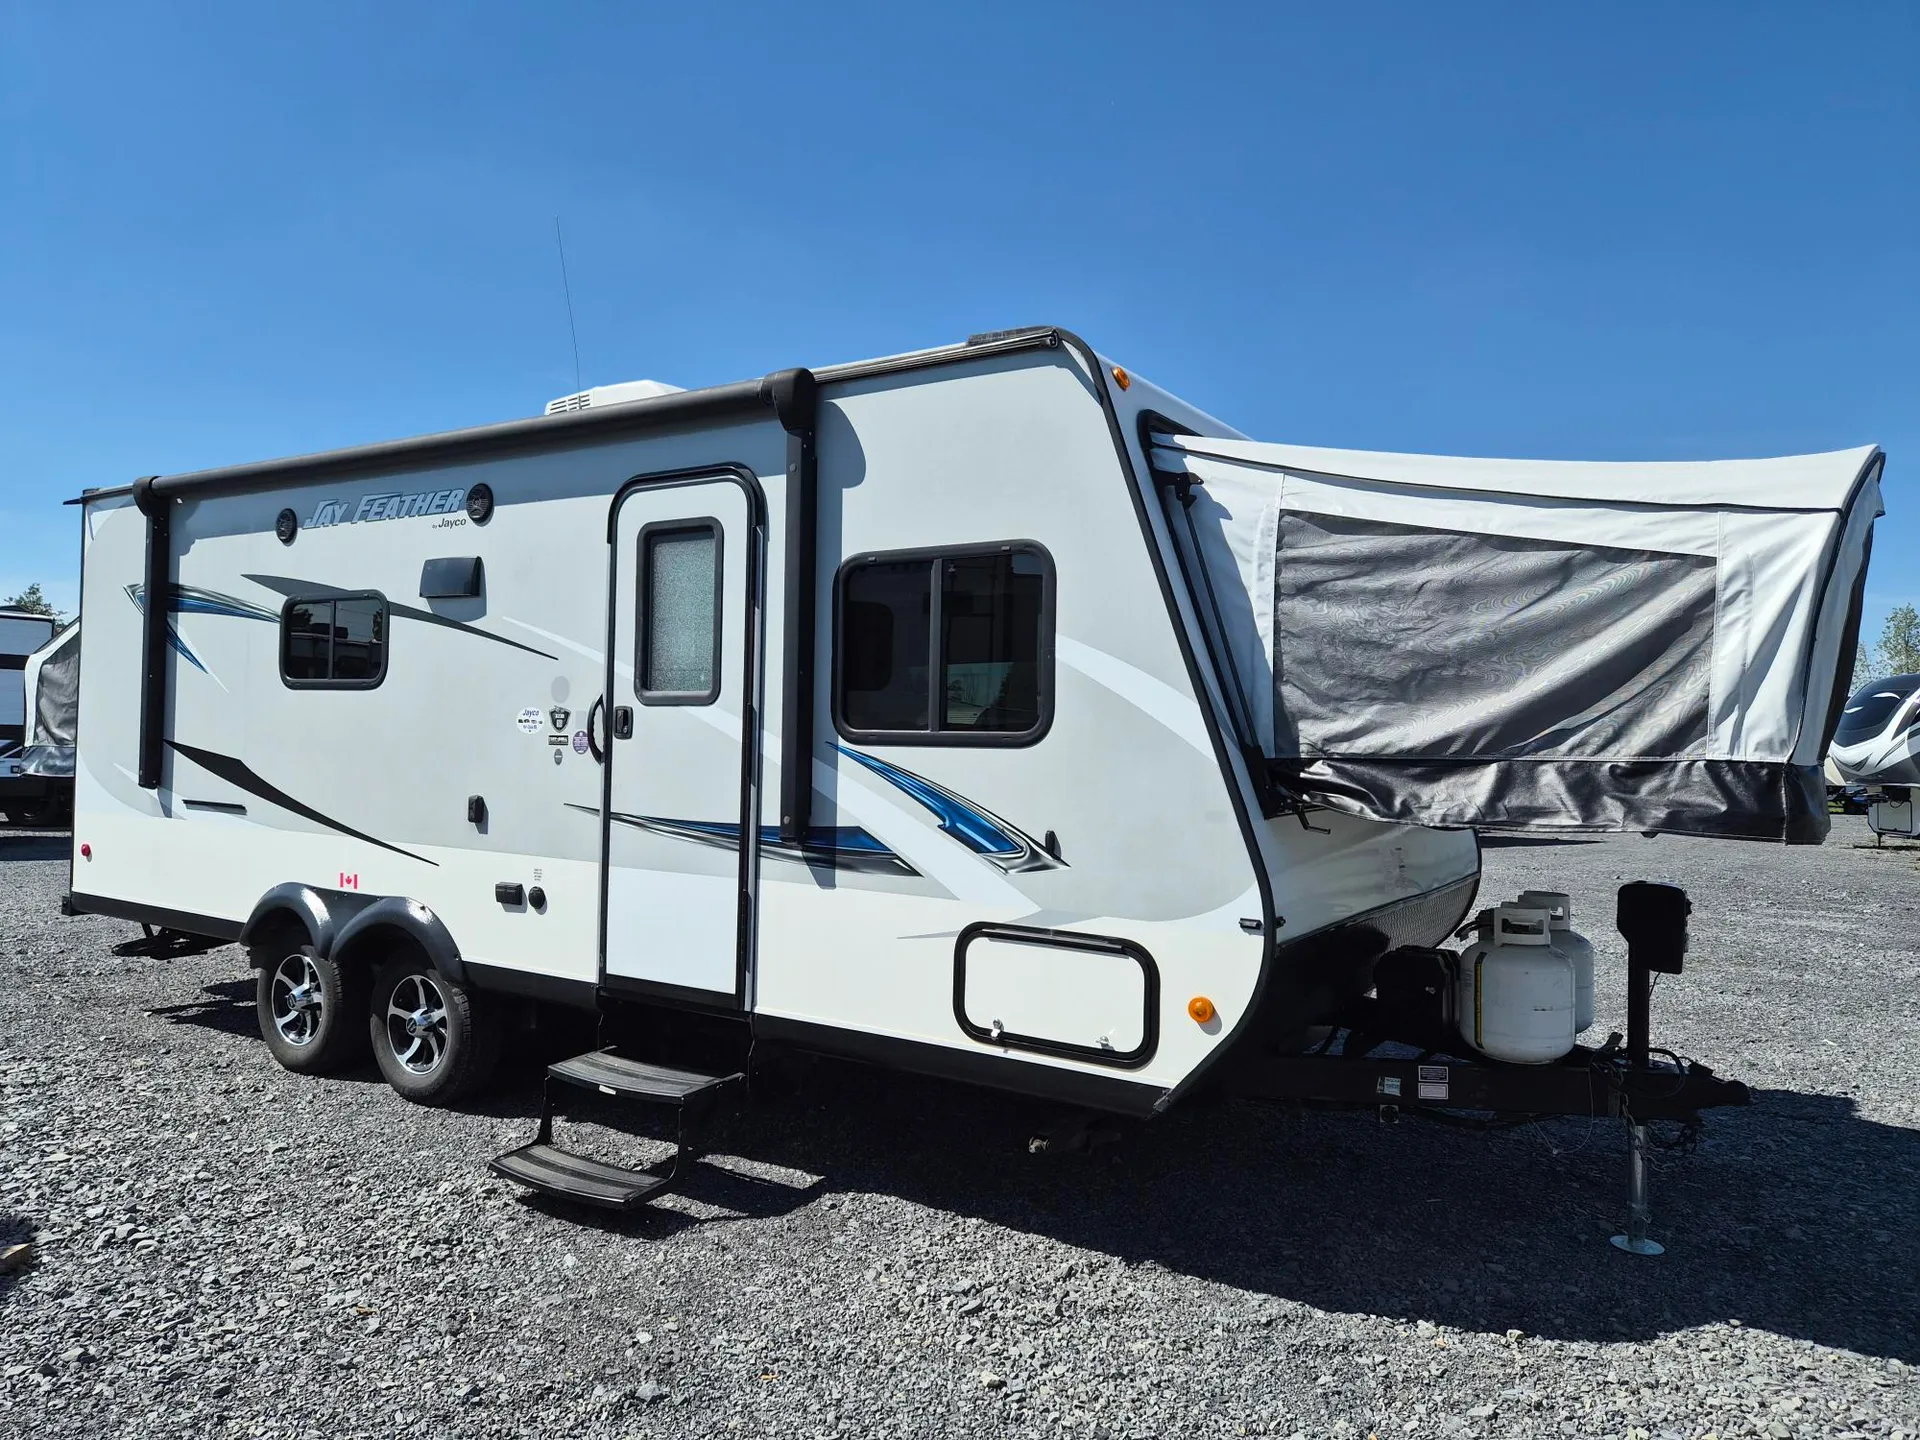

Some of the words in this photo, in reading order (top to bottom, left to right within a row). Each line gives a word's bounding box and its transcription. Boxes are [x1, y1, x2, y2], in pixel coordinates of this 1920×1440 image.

[302, 499, 350, 529] JAY
[351, 488, 466, 524] FEATHER
[438, 517, 466, 528] Jayco
[522, 709, 539, 717] Jayco
